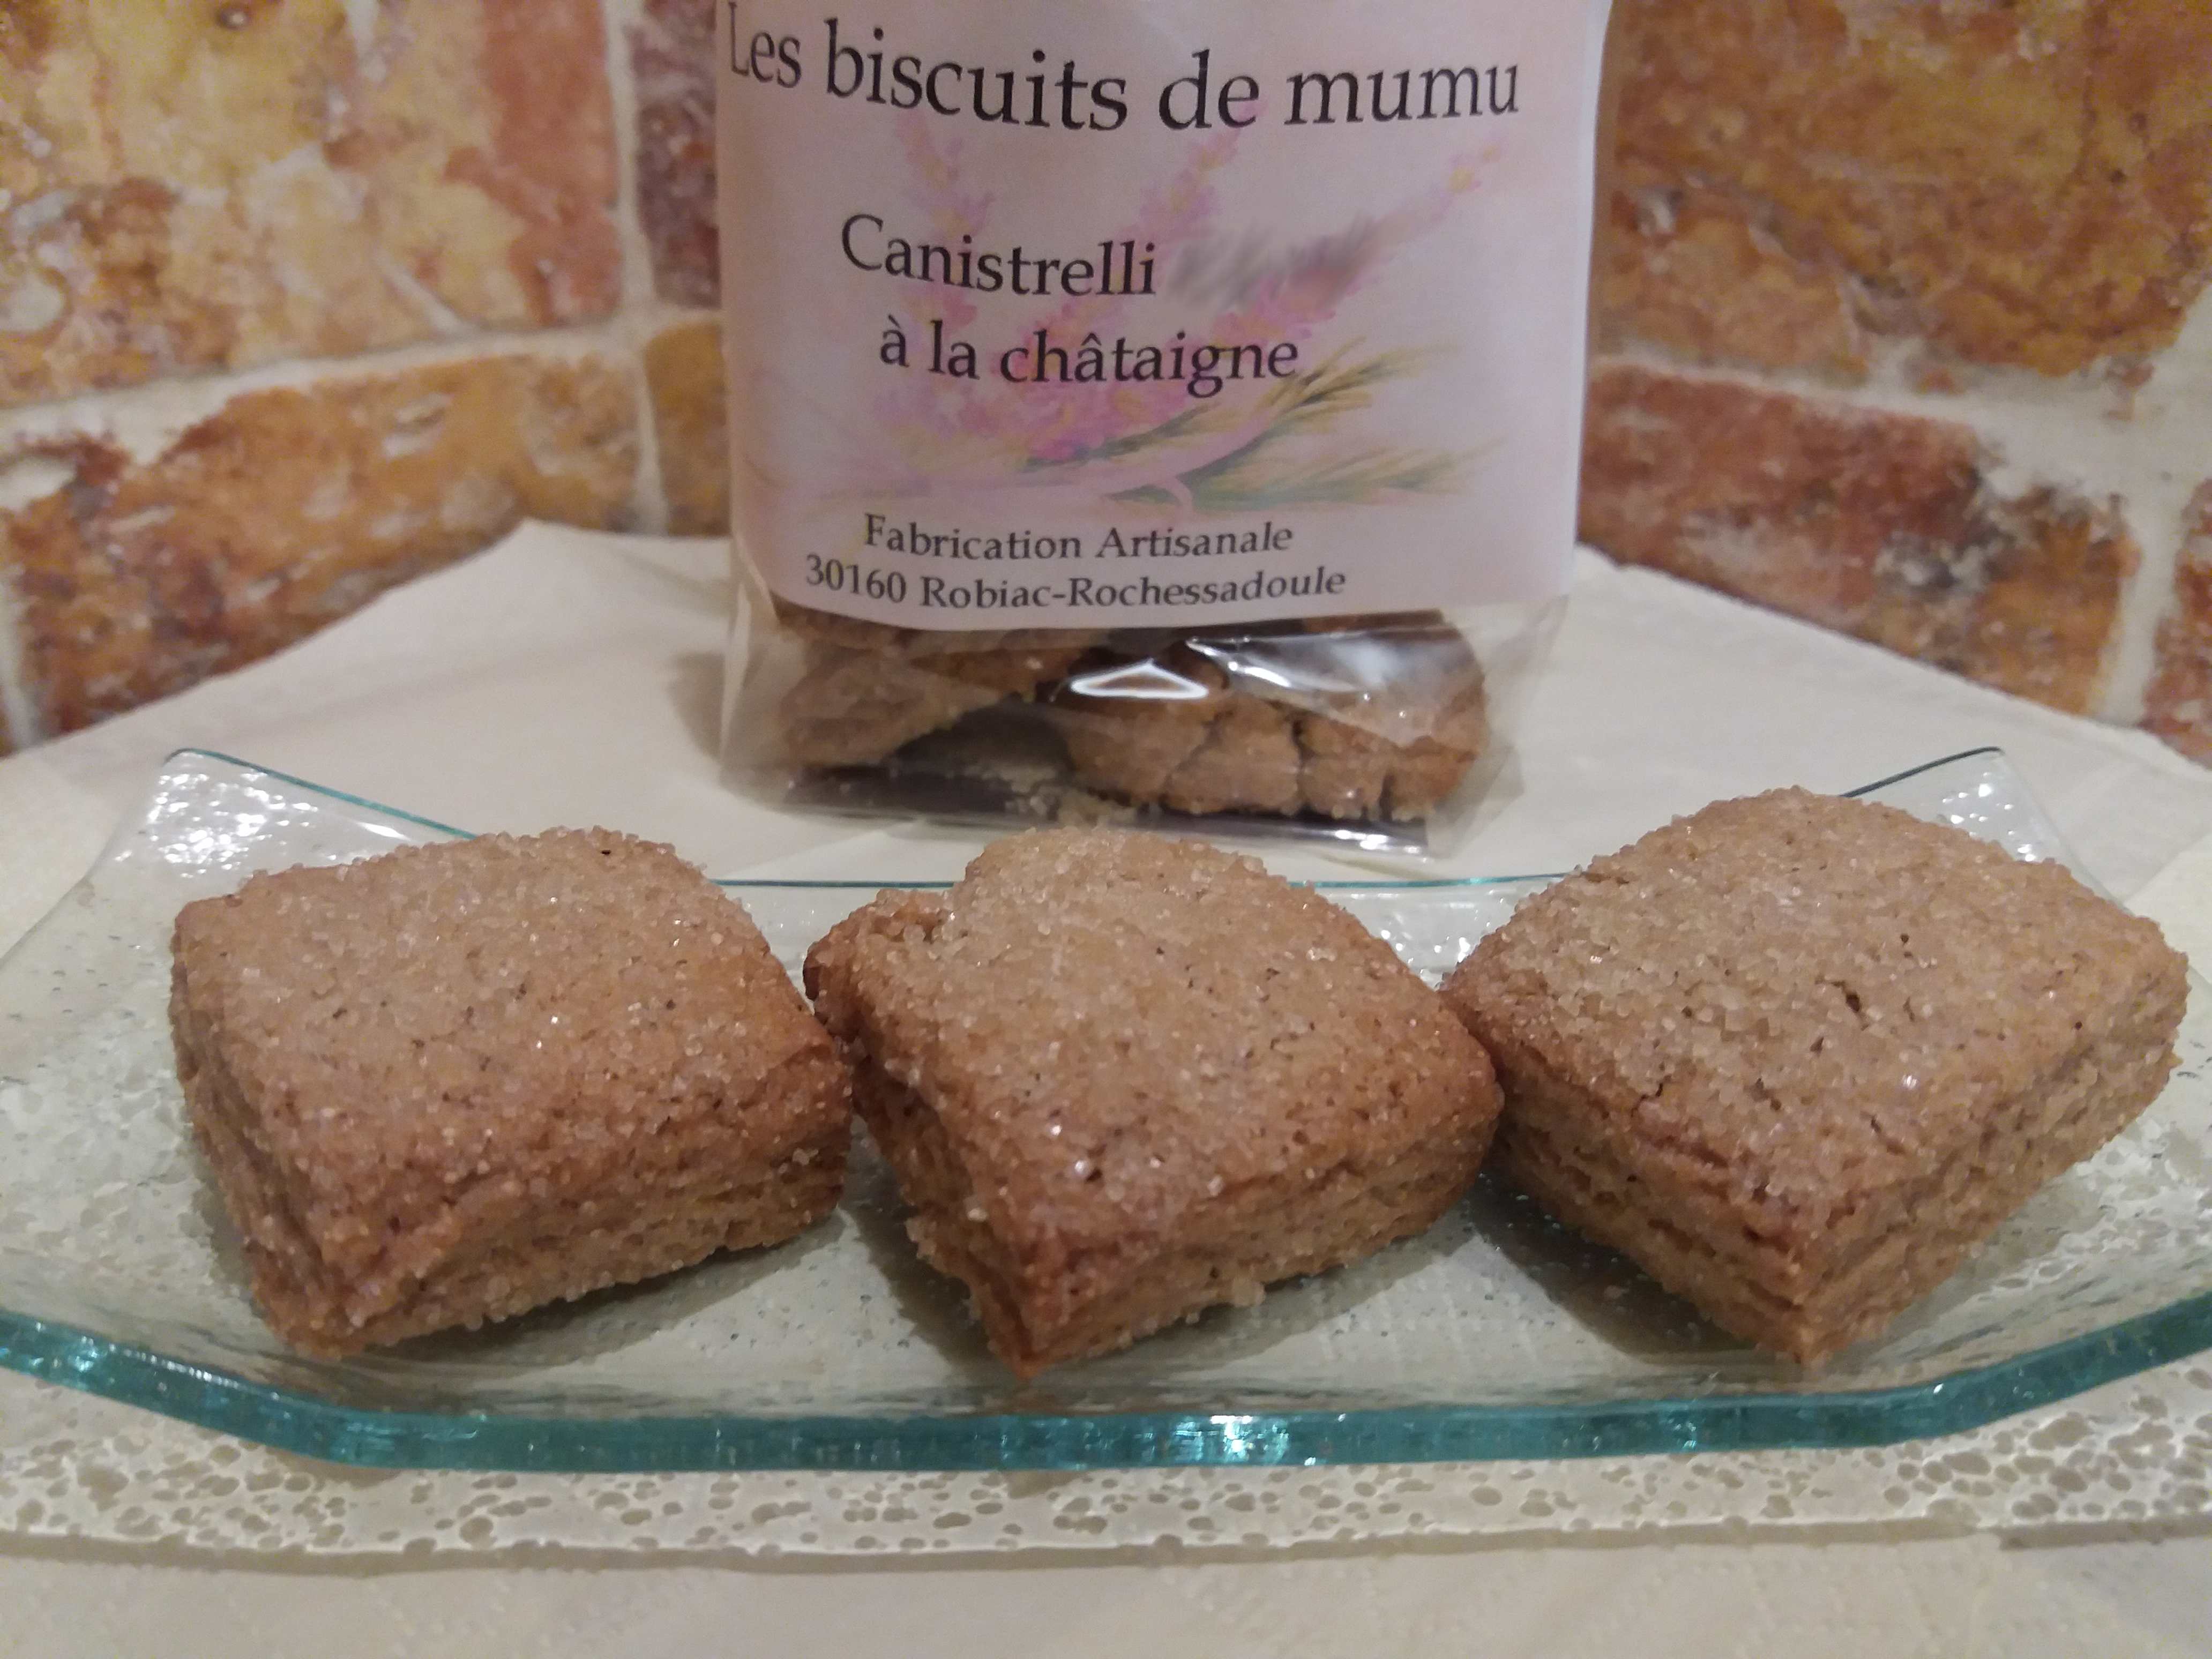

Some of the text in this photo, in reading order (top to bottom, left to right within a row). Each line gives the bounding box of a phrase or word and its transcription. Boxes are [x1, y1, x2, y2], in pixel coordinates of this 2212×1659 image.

[727, 1, 1519, 132] Les biscuits de mumu
[841, 213, 1156, 296] Canistrelli
[879, 314, 1298, 398] à la châtaigne
[863, 513, 1293, 560] Fabrication Artisanale
[805, 554, 1347, 609] 30160 Robiac-Rochessadoule
